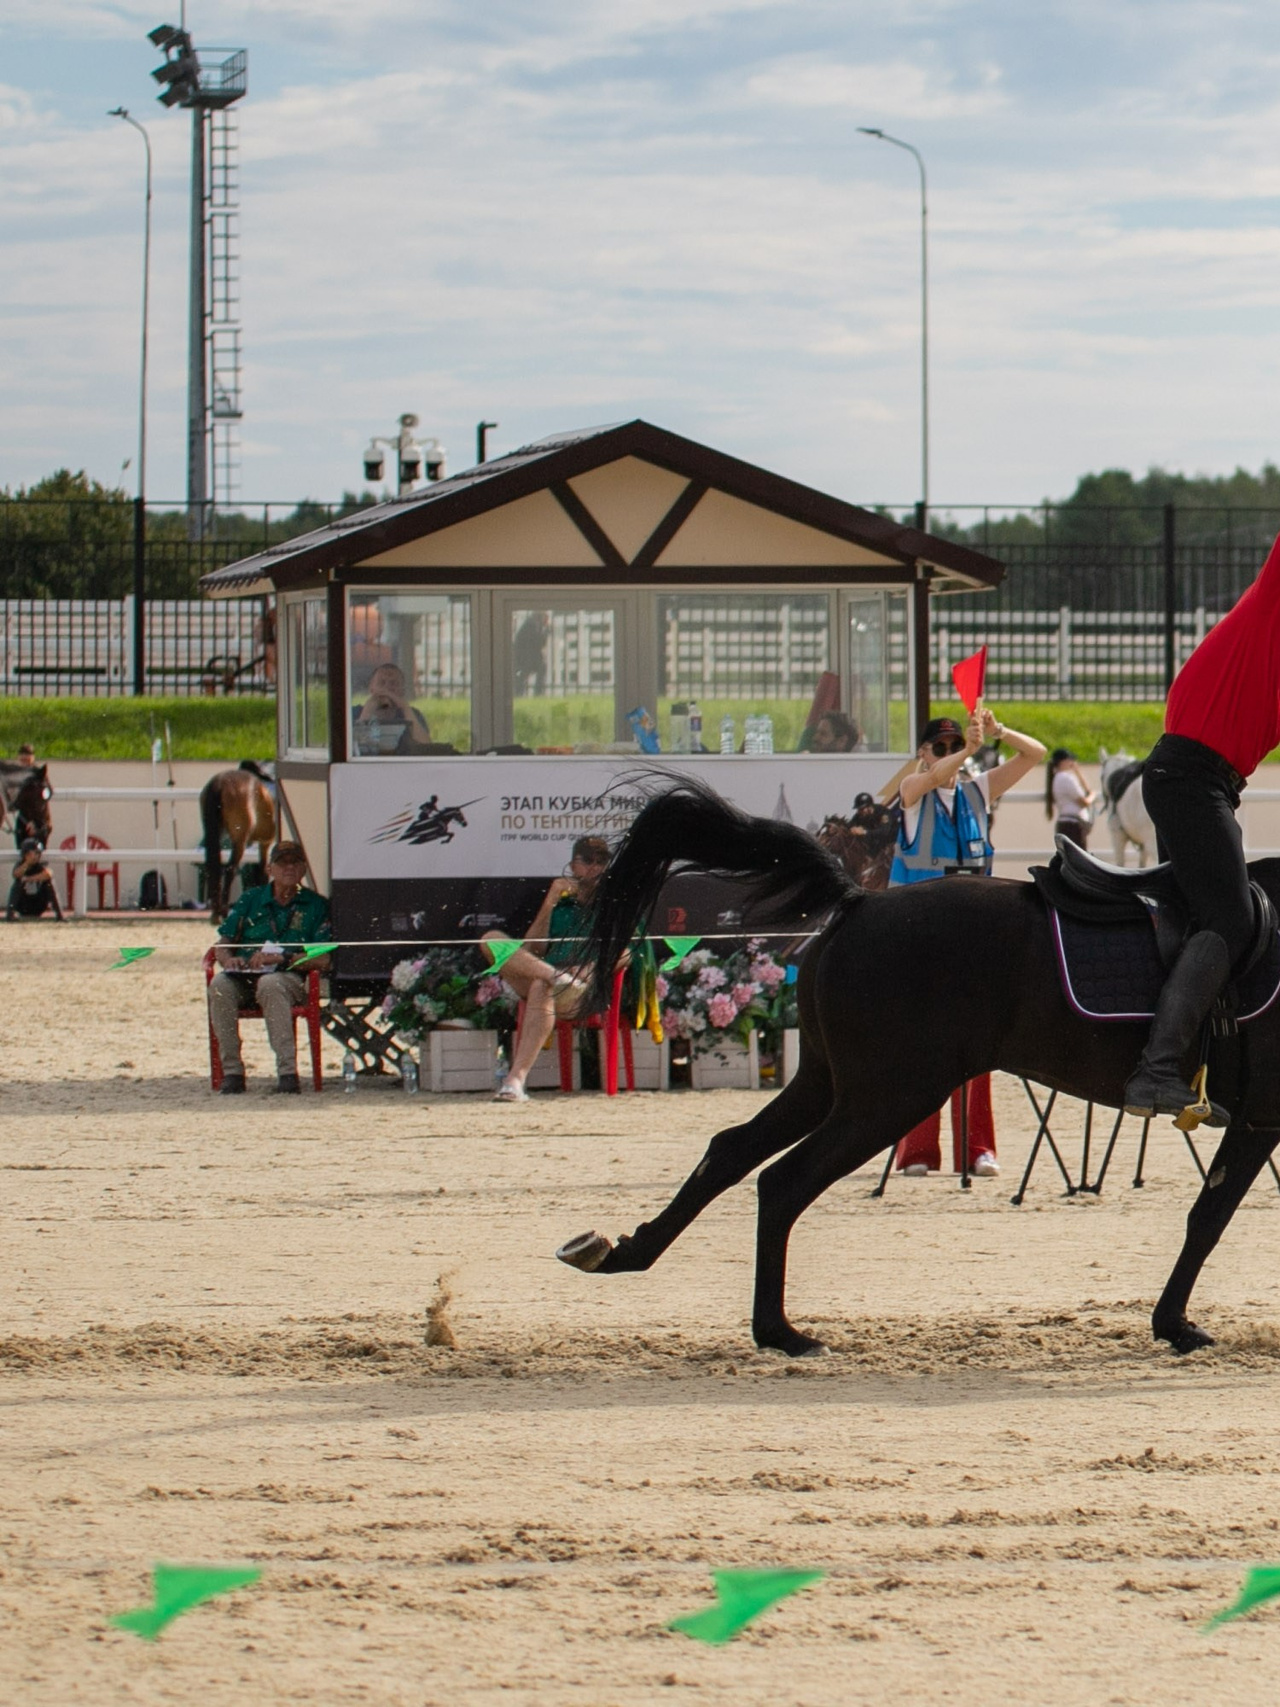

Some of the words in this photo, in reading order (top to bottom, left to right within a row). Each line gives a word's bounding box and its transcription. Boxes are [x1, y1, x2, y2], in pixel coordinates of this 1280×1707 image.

[501, 796, 543, 811] ЭТАП
[549, 796, 604, 811] КУБКА
[611, 796, 646, 811] МИР
[501, 815, 525, 830] ПО
[531, 815, 637, 830] ТЕНТПЕГГИН
[520, 833, 548, 842] WORLD
[550, 833, 567, 842] CUP
